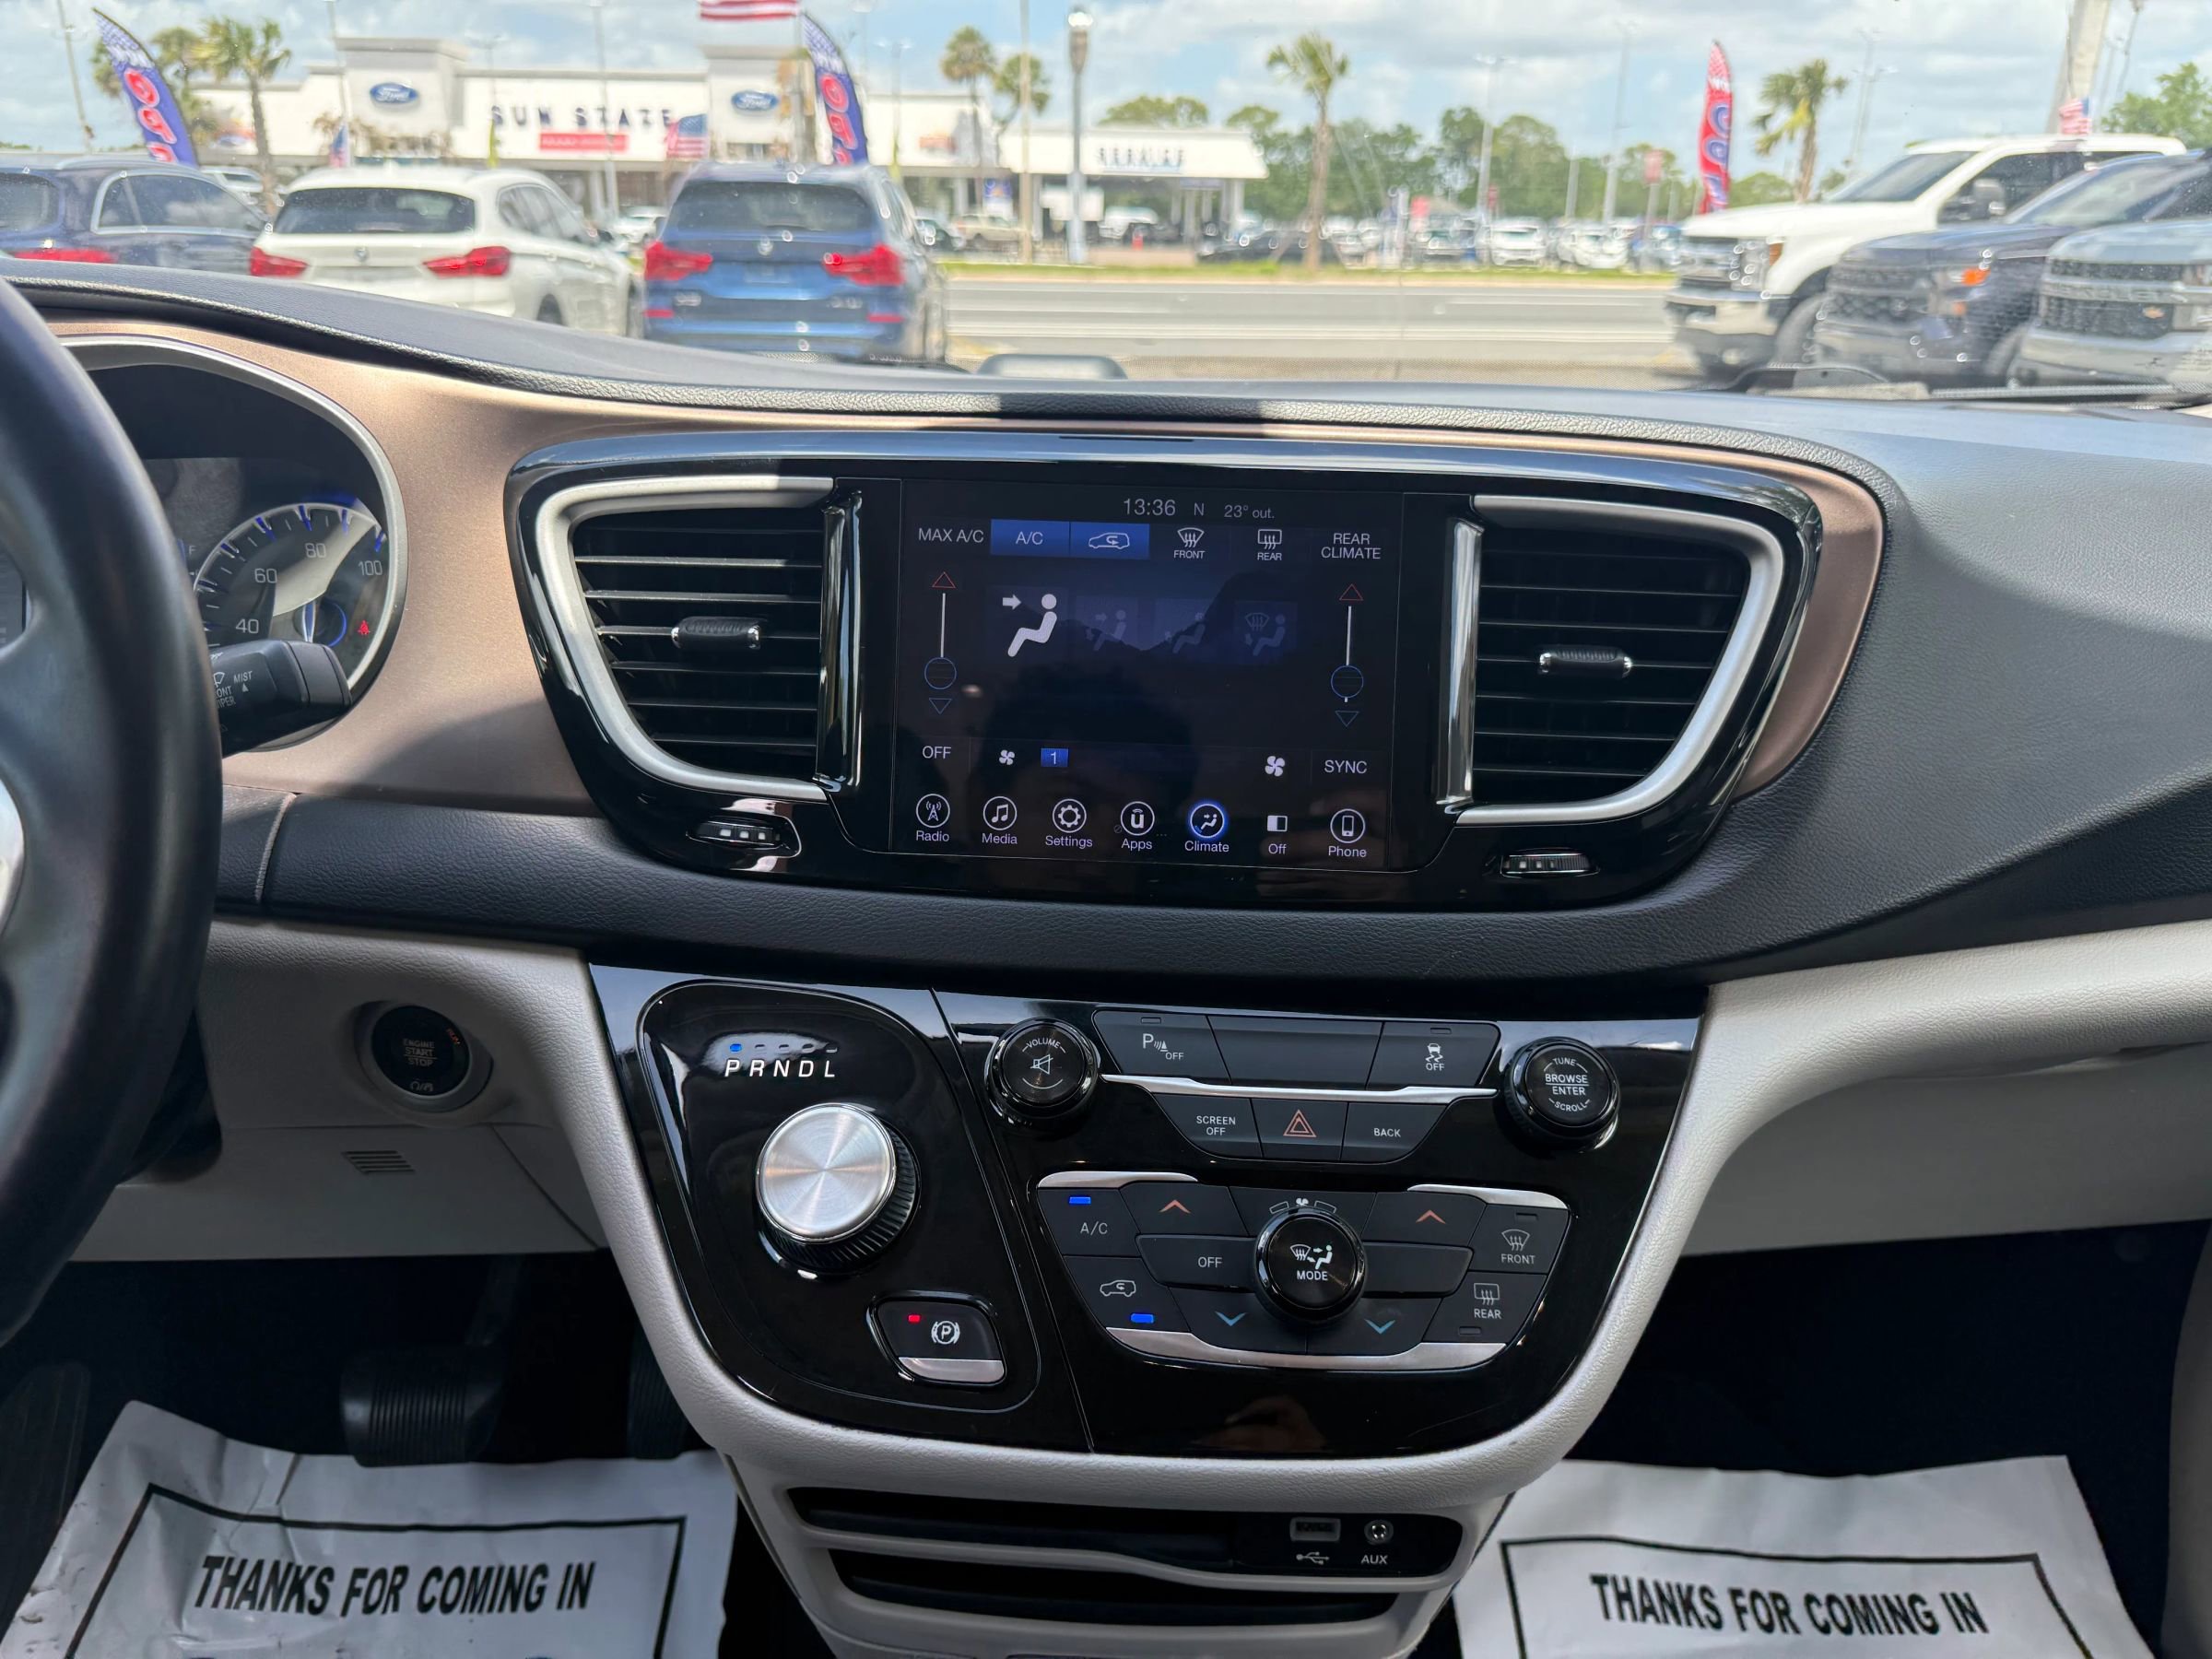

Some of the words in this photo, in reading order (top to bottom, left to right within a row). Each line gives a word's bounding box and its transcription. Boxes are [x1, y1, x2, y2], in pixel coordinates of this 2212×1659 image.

[491, 104, 552, 127] SUN
[575, 106, 672, 128] STATE
[1123, 499, 1176, 516] 13:36
[1194, 503, 1205, 516] N
[1252, 507, 1275, 519] out.
[918, 528, 953, 542] MAX
[957, 530, 984, 543] A/C
[1016, 532, 1043, 545] A/C
[1333, 533, 1371, 545] REAR
[305, 543, 326, 558] 80
[1173, 550, 1206, 559] FRONT
[1257, 552, 1282, 561] REAR
[1321, 547, 1382, 559] CLIMATE
[359, 560, 382, 576] 100
[254, 569, 276, 583] 60
[235, 618, 259, 634] 40
[233, 670, 253, 684] MIST
[216, 685, 232, 698] ONT
[218, 695, 237, 709] IPER
[923, 746, 951, 759] OFF
[1051, 752, 1057, 764] 1
[1324, 760, 1368, 774] SYNC
[916, 830, 950, 842] Radio
[982, 833, 1018, 845] Media
[1045, 835, 1093, 849] Settings
[1121, 838, 1152, 851] Apps
[1184, 840, 1230, 853] Climate
[1268, 843, 1287, 854] Off
[1328, 846, 1367, 857] Phone
[403, 1039, 435, 1049] ENGINE
[1026, 1039, 1061, 1049] VOLUME
[405, 1046, 433, 1057] START
[1165, 1052, 1184, 1060] OFF
[407, 1057, 433, 1067] STOP
[1426, 1063, 1444, 1071] OFF
[1553, 1057, 1576, 1067] TUNE
[1546, 1074, 1588, 1084] BROWSE
[1552, 1087, 1585, 1096] ENTER
[1554, 1101, 1587, 1112] SCROLL
[1196, 1115, 1235, 1125] SCREEN
[1206, 1126, 1226, 1135] OFF
[1373, 1127, 1401, 1137] BACK
[1079, 1222, 1108, 1235] A/C
[1197, 1256, 1223, 1268] OFF
[1500, 1253, 1535, 1265] FRONT
[1296, 1270, 1328, 1281] MODE
[1474, 1308, 1501, 1319] REAR
[1360, 1555, 1389, 1564] AUX
[194, 1555, 335, 1615] THANKS
[340, 1565, 409, 1618] FOR
[417, 1562, 547, 1614] COMING
[556, 1561, 596, 1609] IN
[1590, 1574, 1724, 1630] THANKS
[1730, 1587, 1801, 1635] FOR
[1805, 1593, 1939, 1635] COMING
[1940, 1592, 1989, 1635] IN
